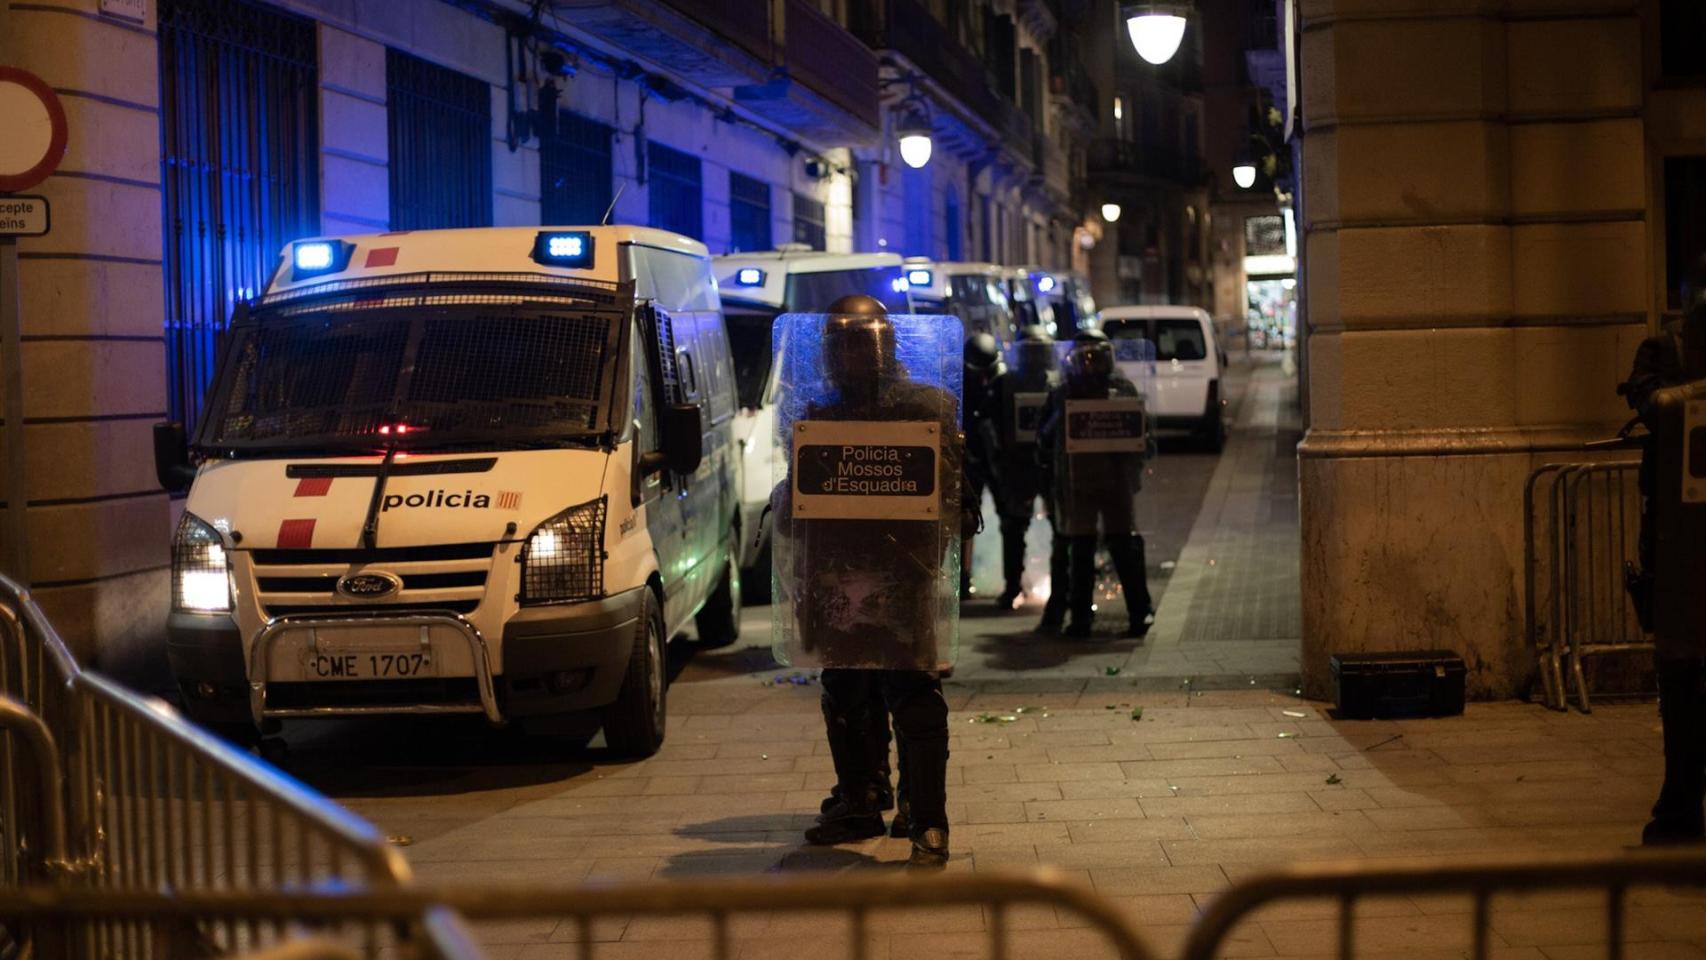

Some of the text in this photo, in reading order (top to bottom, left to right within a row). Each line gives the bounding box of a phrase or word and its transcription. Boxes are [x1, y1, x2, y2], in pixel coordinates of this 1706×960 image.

[838, 461, 903, 476] Mossos
[823, 477, 917, 495] d'Esquadra
[382, 489, 490, 512] policia
[351, 580, 383, 592] Ford
[317, 654, 423, 677] CME 1707
